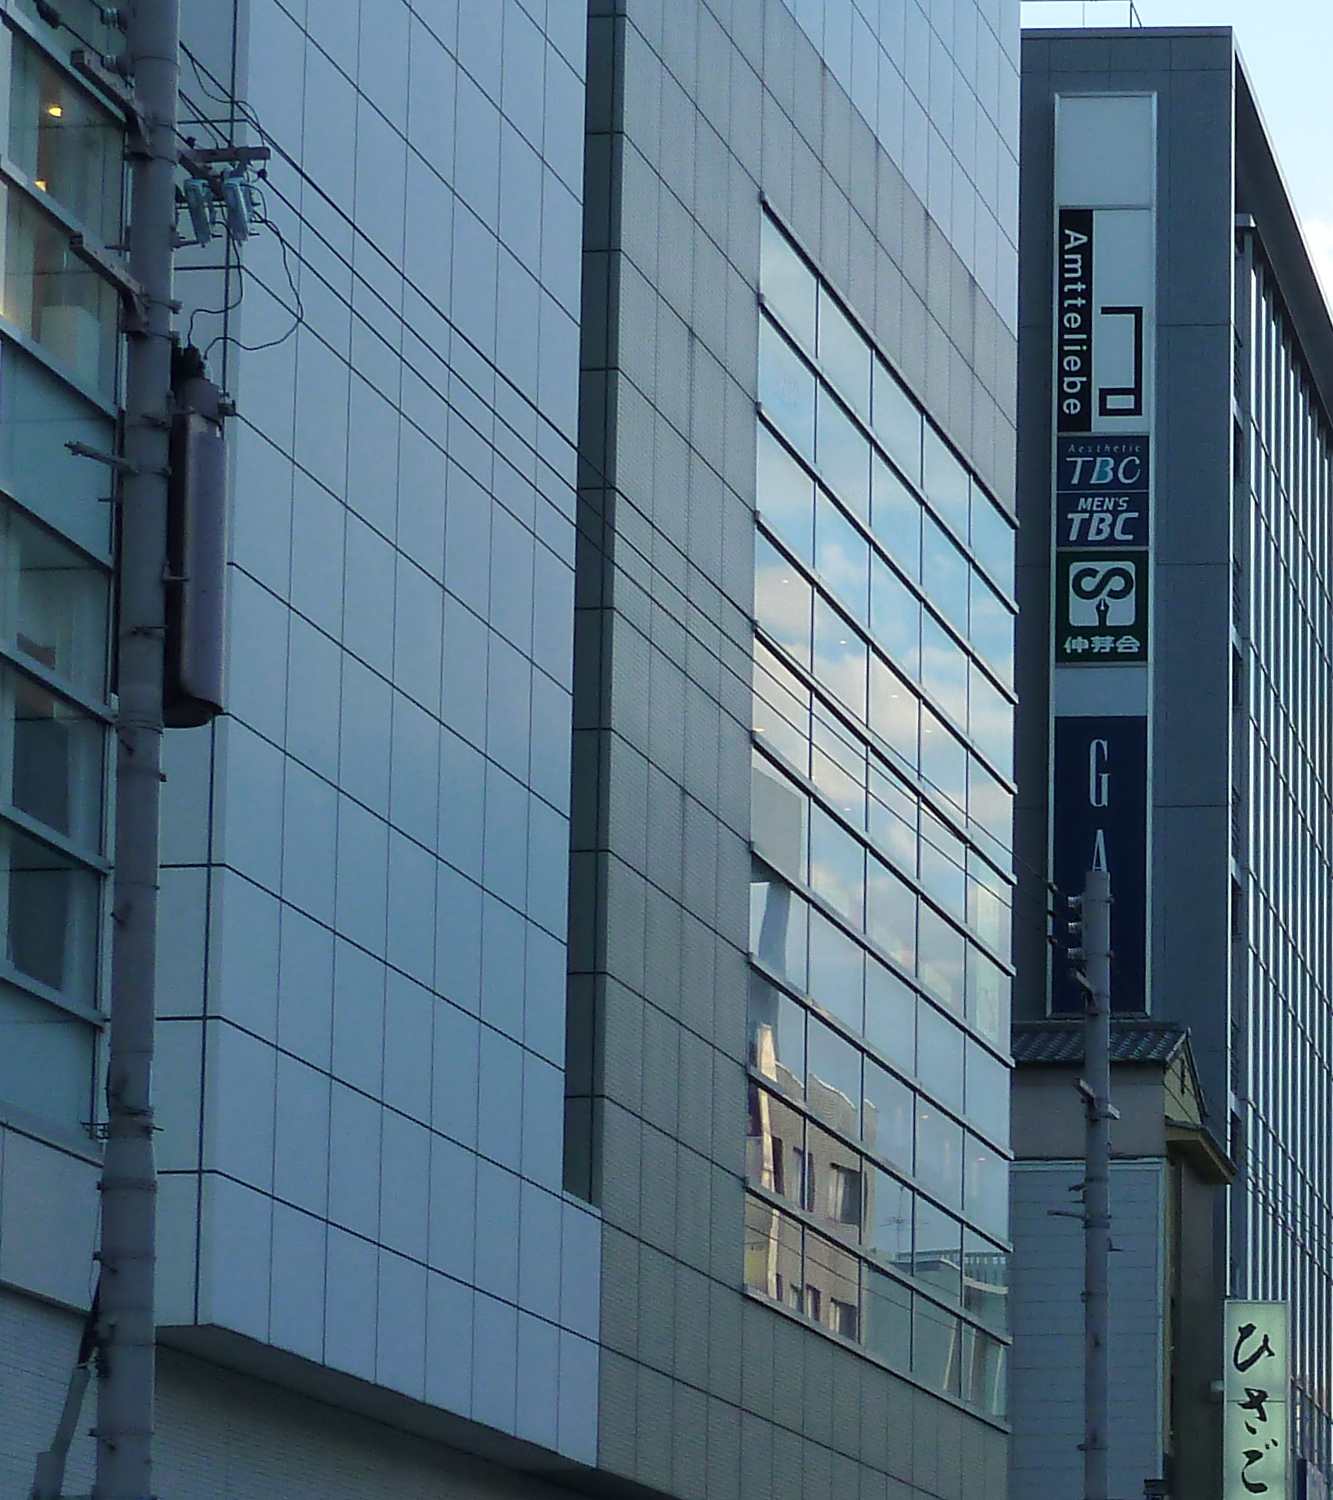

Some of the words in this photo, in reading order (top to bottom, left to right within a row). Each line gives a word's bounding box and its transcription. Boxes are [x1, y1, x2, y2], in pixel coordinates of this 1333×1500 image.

[1062, 228, 1089, 416] Amtteliebe
[1068, 443, 1142, 454] Aesthetic
[1066, 456, 1141, 485] TBC
[1078, 496, 1129, 512] MEN'S
[1067, 512, 1140, 541] TBC
